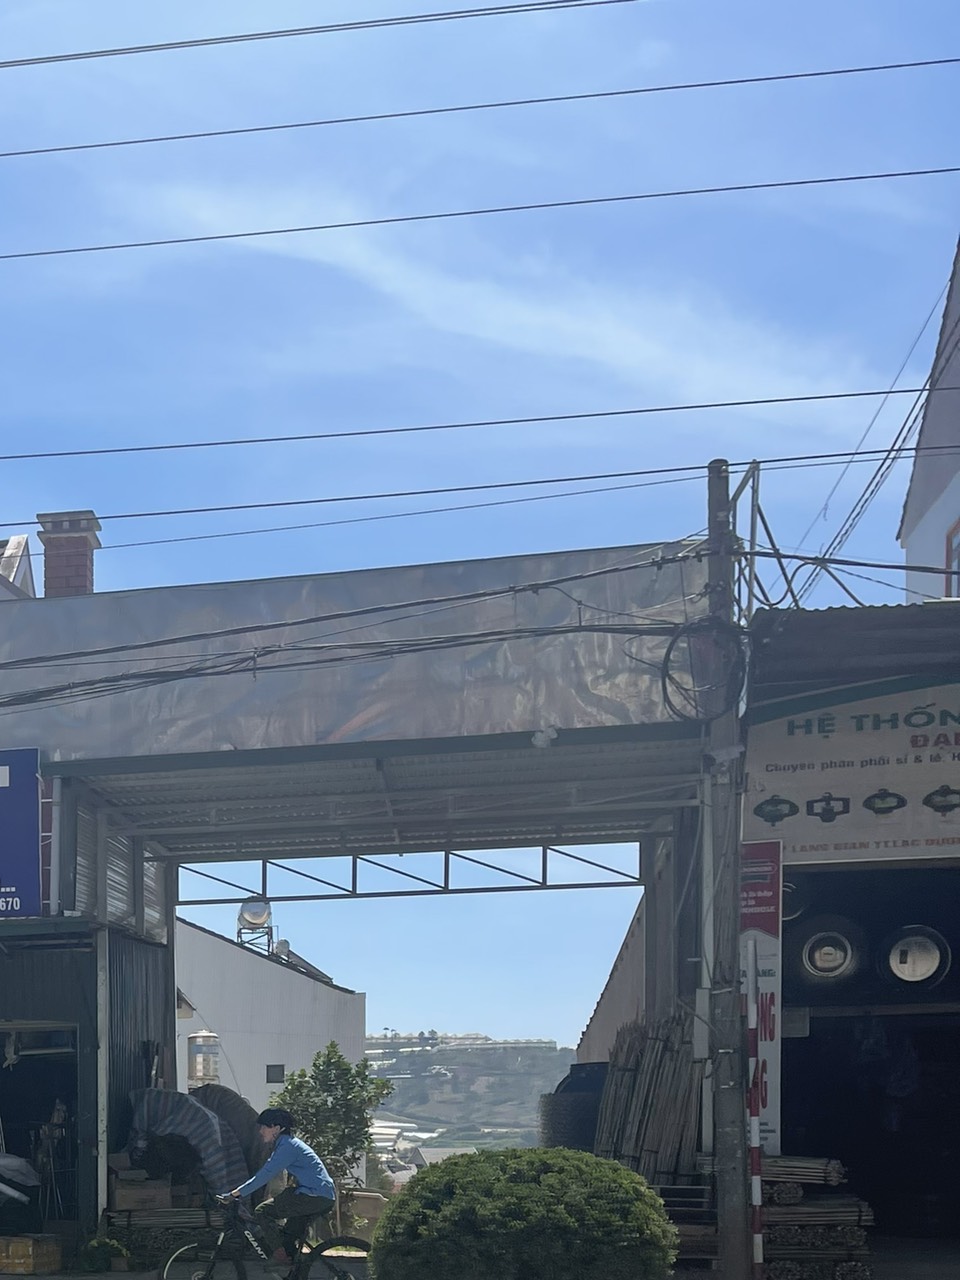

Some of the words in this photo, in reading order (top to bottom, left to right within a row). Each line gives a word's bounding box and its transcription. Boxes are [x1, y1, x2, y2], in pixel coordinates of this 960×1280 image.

[787, 713, 837, 739] HỆ
[0, 897, 21, 911] 670
[243, 1230, 269, 1260] GIANT
